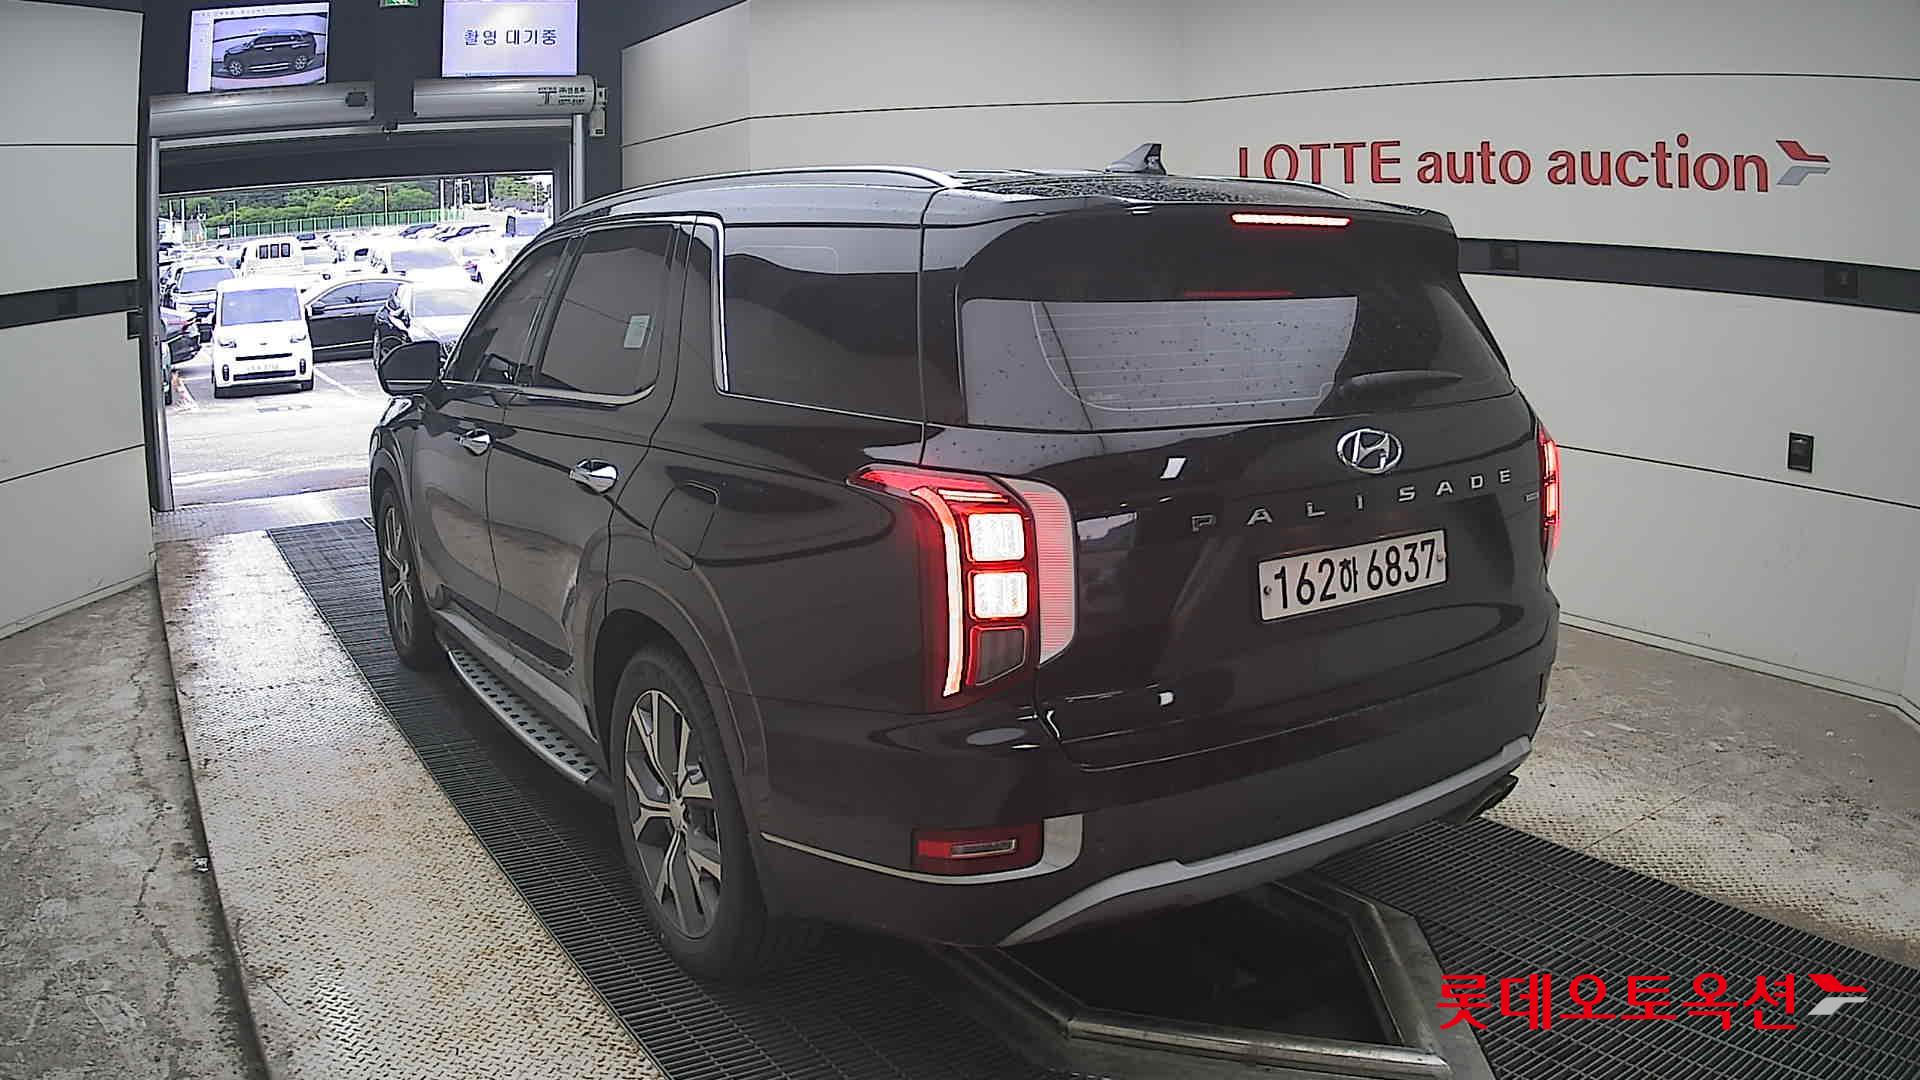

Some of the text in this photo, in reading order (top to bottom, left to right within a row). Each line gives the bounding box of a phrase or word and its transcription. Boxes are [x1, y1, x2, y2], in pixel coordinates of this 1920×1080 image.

[505, 29, 557, 46] 대기중
[1416, 141, 1532, 185] auto
[1547, 134, 1769, 192] auction
[1191, 469, 1511, 532] PALISADE
